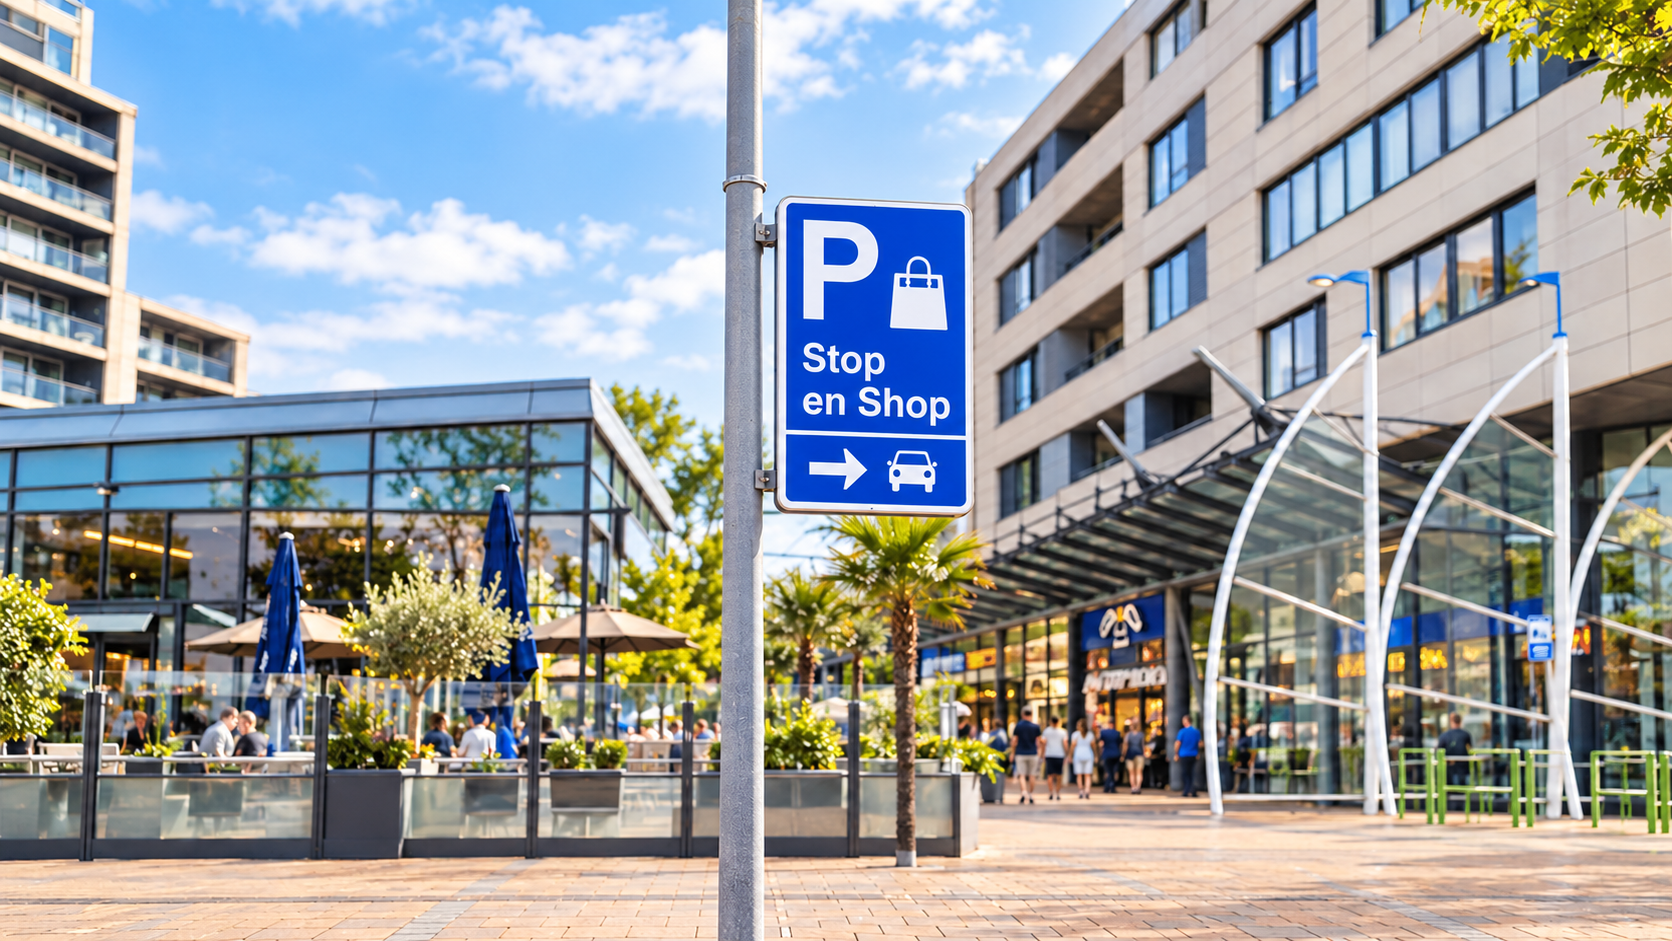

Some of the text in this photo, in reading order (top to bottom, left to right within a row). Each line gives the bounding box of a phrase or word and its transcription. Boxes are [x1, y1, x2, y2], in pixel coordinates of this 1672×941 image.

[803, 219, 879, 320] P
[803, 342, 886, 382] Stop
[803, 386, 951, 427] en Shop
